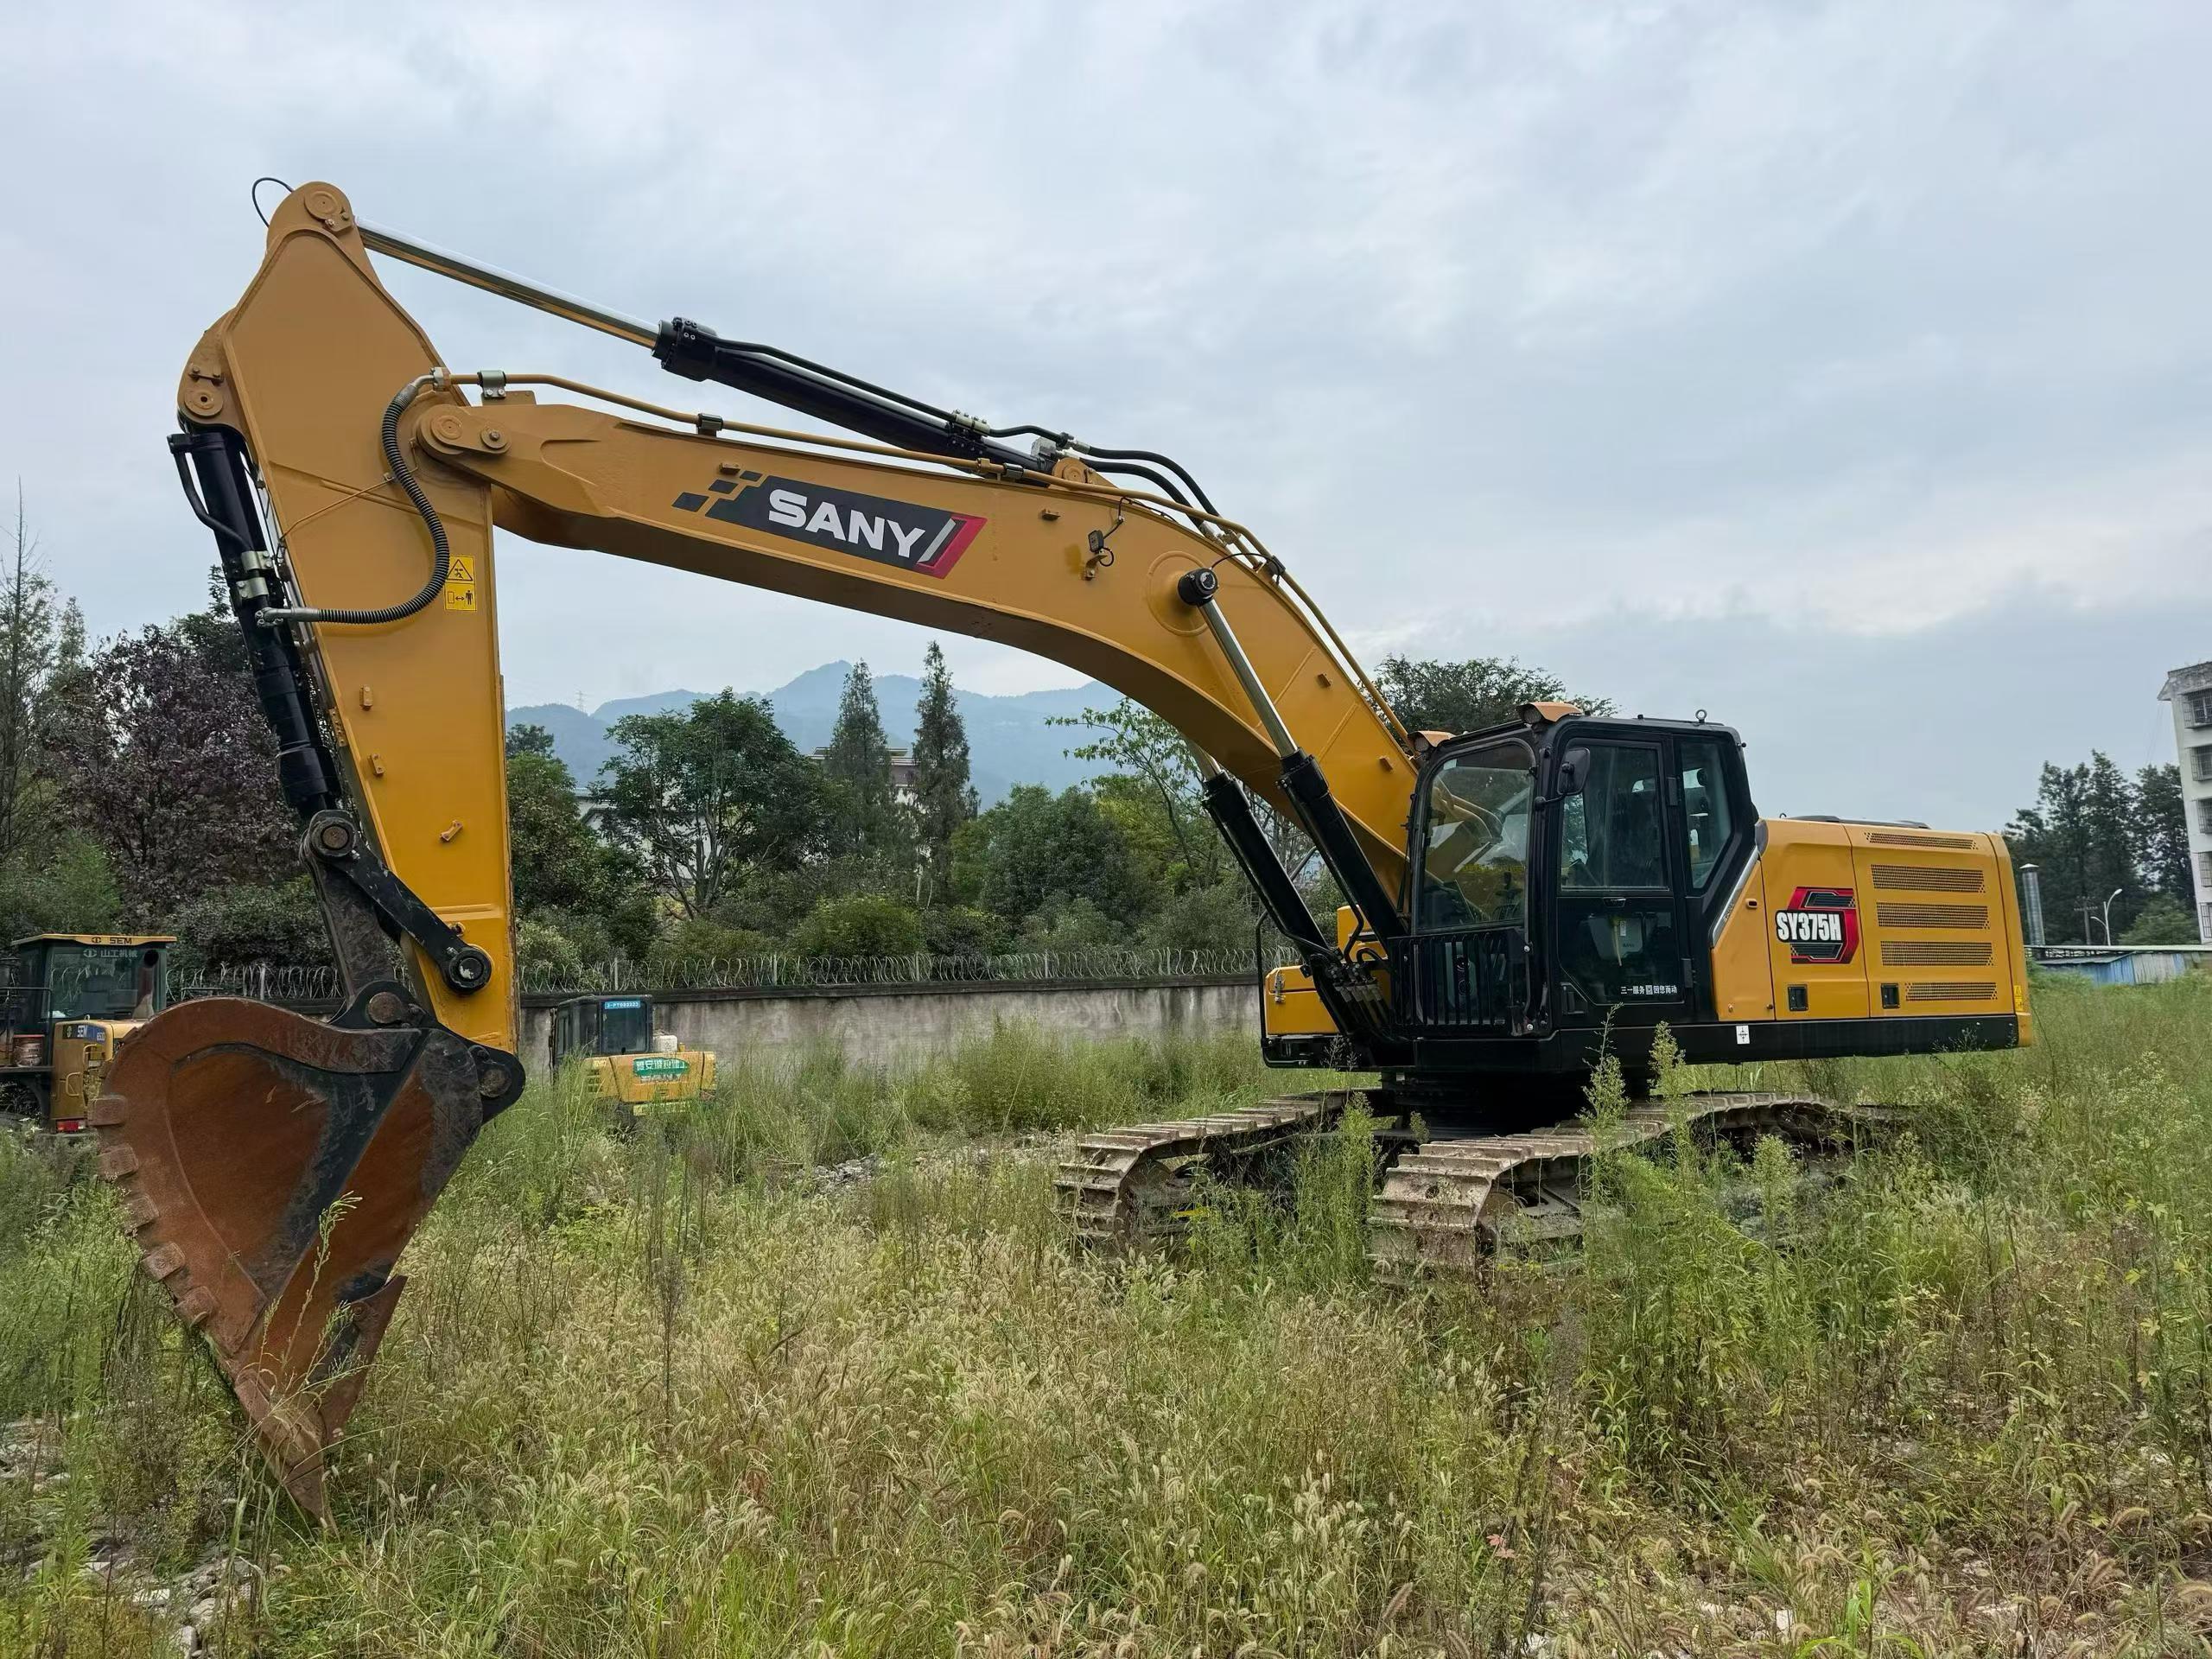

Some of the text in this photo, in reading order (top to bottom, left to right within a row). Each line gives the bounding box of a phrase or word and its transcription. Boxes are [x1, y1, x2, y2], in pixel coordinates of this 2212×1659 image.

[768, 489, 925, 558] SANY
[1777, 912, 1842, 941] SY375H
[100, 948, 138, 958] 山工机械
[1621, 985, 1678, 995] 三一服务 因您而动
[77, 1025, 88, 1037] SEM
